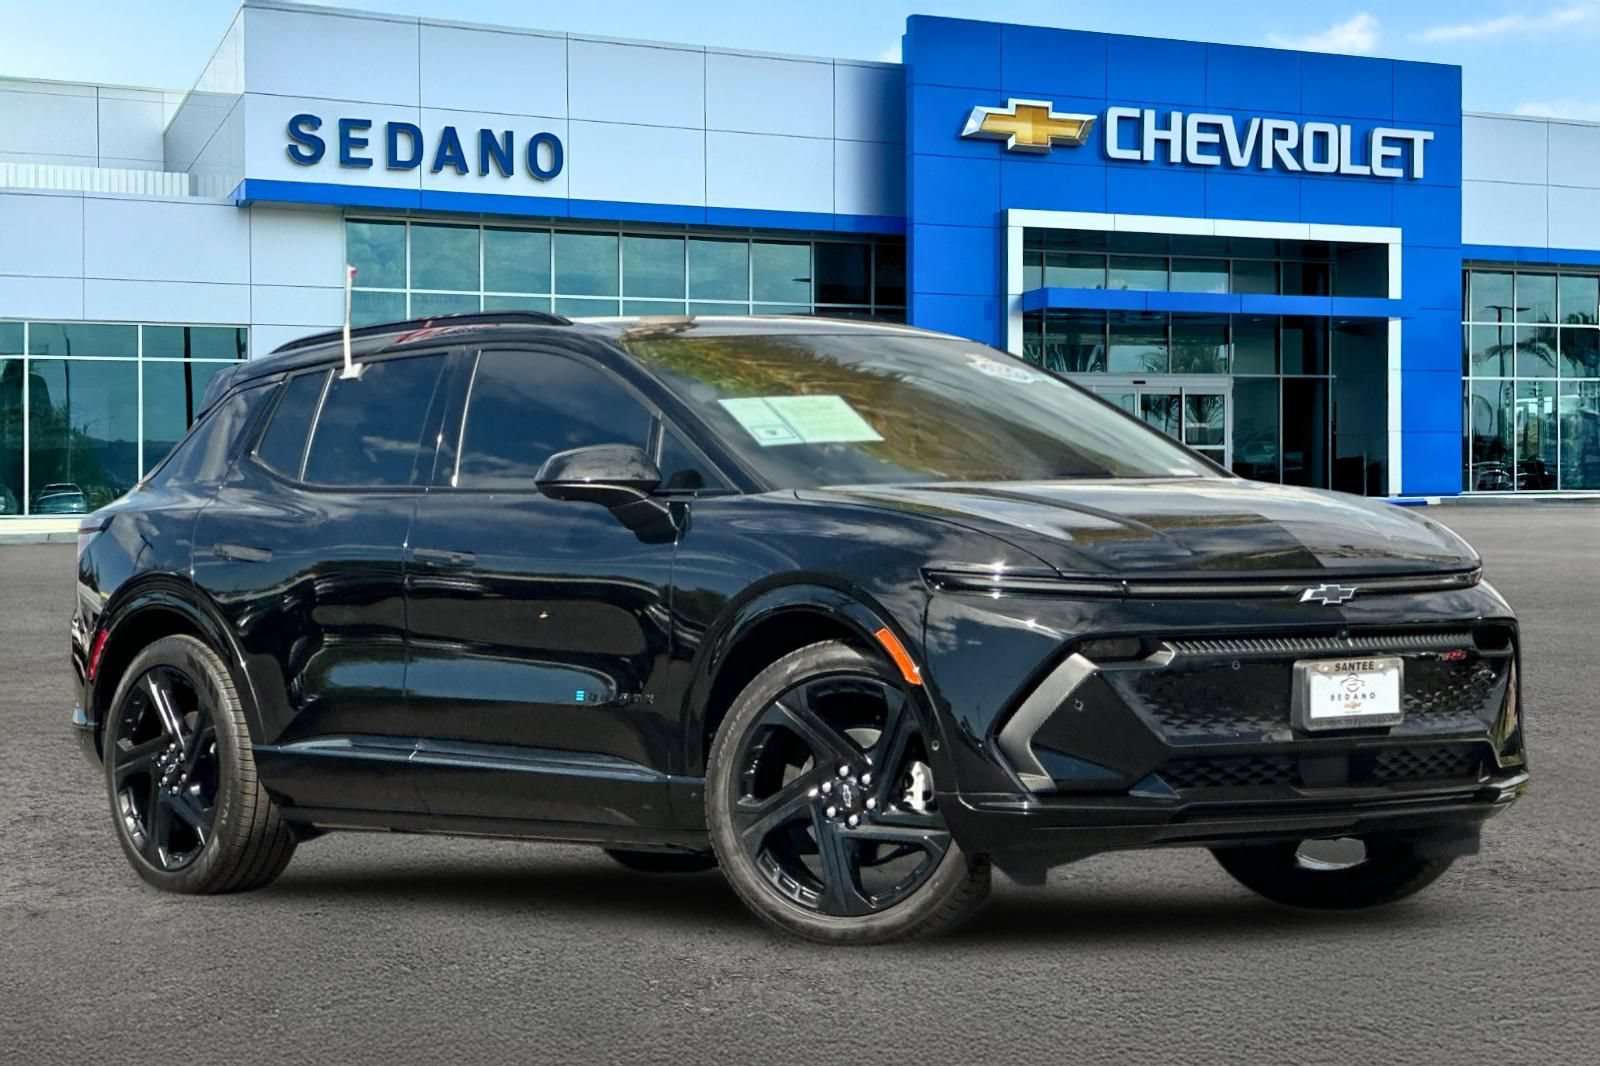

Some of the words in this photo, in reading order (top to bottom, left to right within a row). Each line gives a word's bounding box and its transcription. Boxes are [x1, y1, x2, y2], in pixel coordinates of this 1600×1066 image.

[287, 113, 564, 181] SEDANO
[1105, 106, 1435, 179] CHEVROLET
[1334, 661, 1375, 672] SANTEE
[1330, 692, 1376, 701] SEDANO
